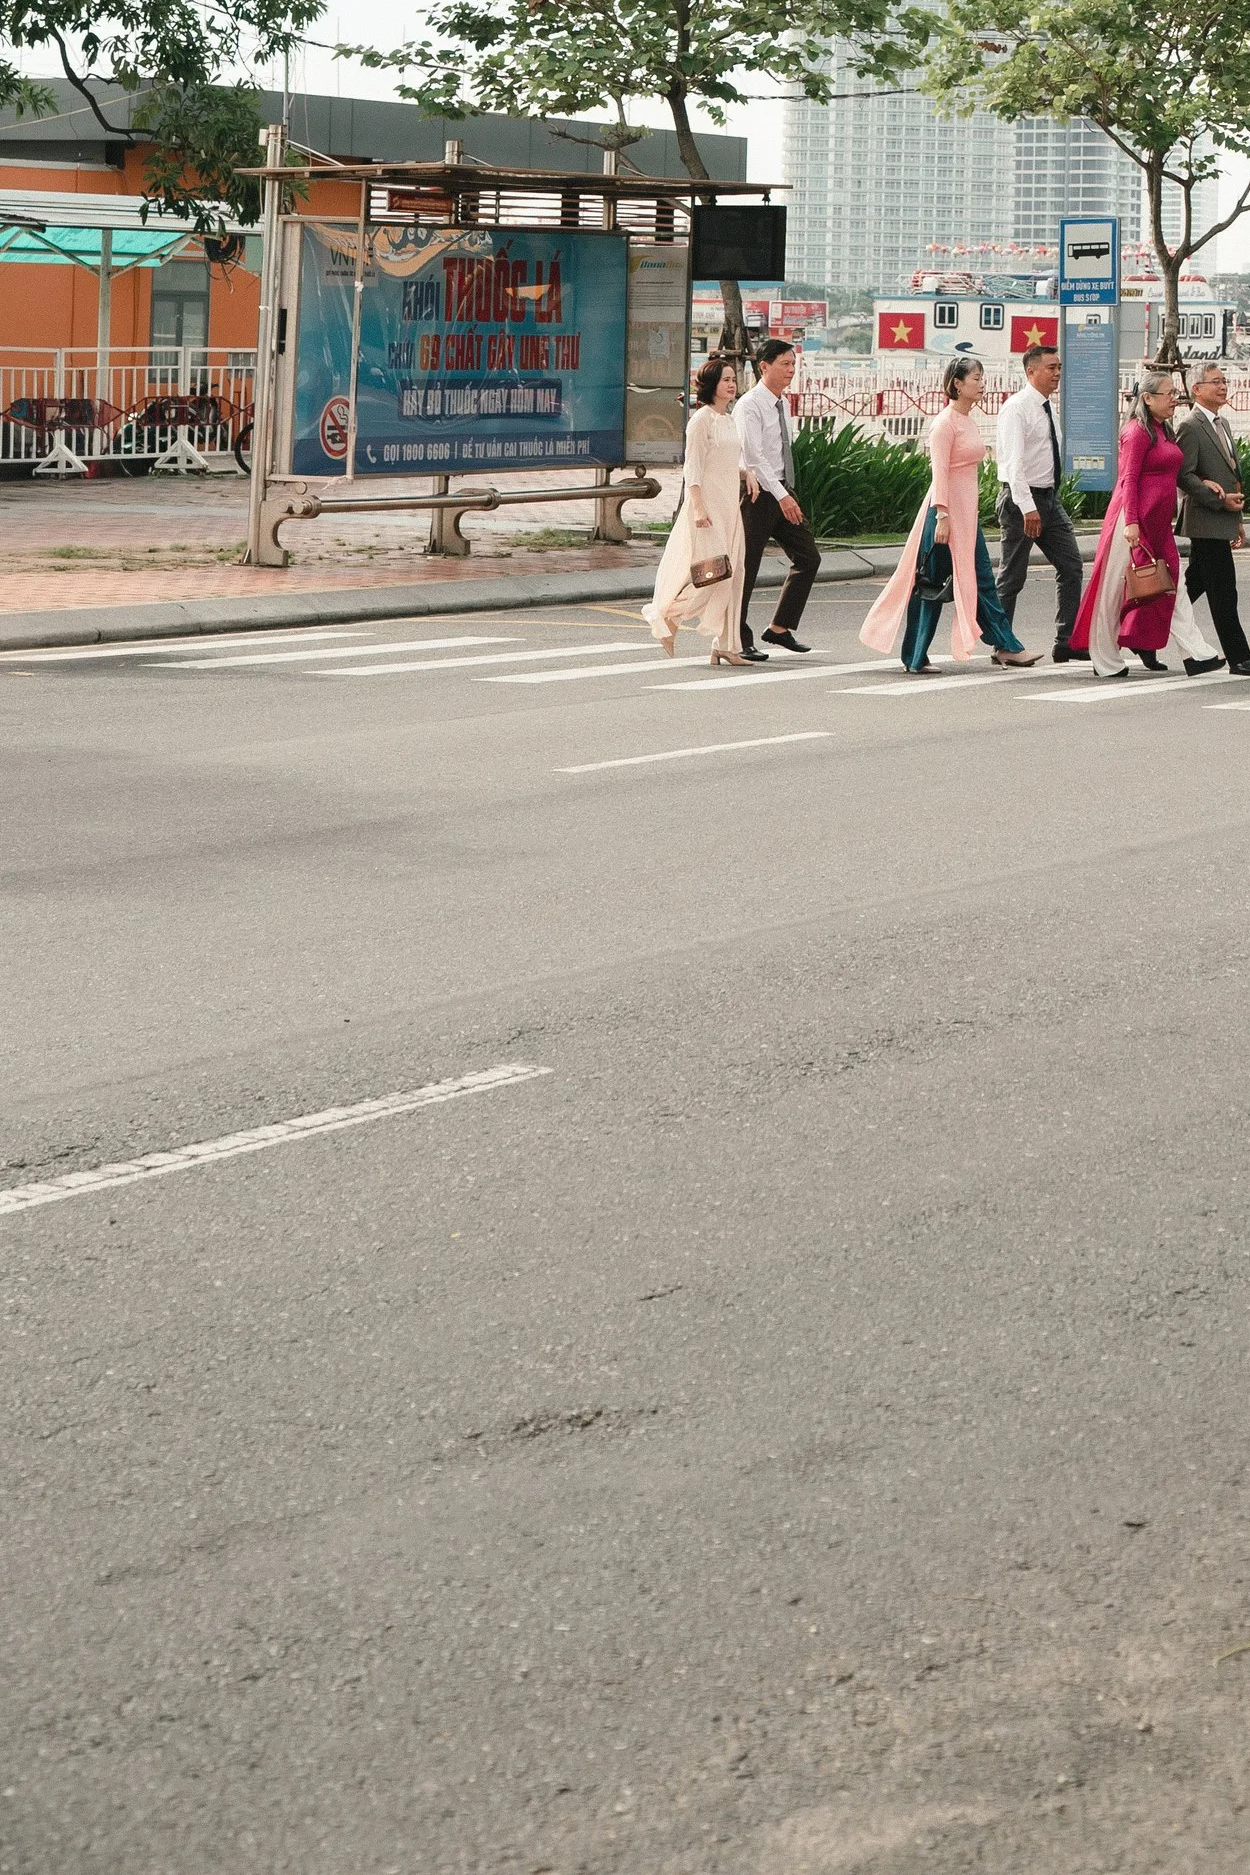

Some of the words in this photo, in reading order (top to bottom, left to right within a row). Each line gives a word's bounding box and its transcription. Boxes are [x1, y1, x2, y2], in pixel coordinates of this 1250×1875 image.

[402, 274, 441, 321] KHÓI
[443, 238, 528, 323] THUỐC
[535, 250, 562, 323] LÁ
[1091, 281, 1100, 290] XE
[1073, 293, 1085, 302] BUS
[1085, 293, 1100, 302] STOP
[419, 334, 441, 371] 69
[445, 323, 483, 370] CHẤT
[487, 328, 516, 371] GÂY
[520, 334, 549, 371] UNG
[554, 331, 582, 371] THƯ
[444, 380, 478, 415] THUỐC
[479, 388, 509, 414] NGAY
[536, 388, 558, 413] NAY
[383, 444, 400, 465] GỌI
[426, 442, 450, 461] 6606
[503, 440, 517, 457] CAI
[518, 436, 543, 456] THUỐC
[544, 438, 554, 456] LÁ
[577, 437, 591, 455] PHÍ
